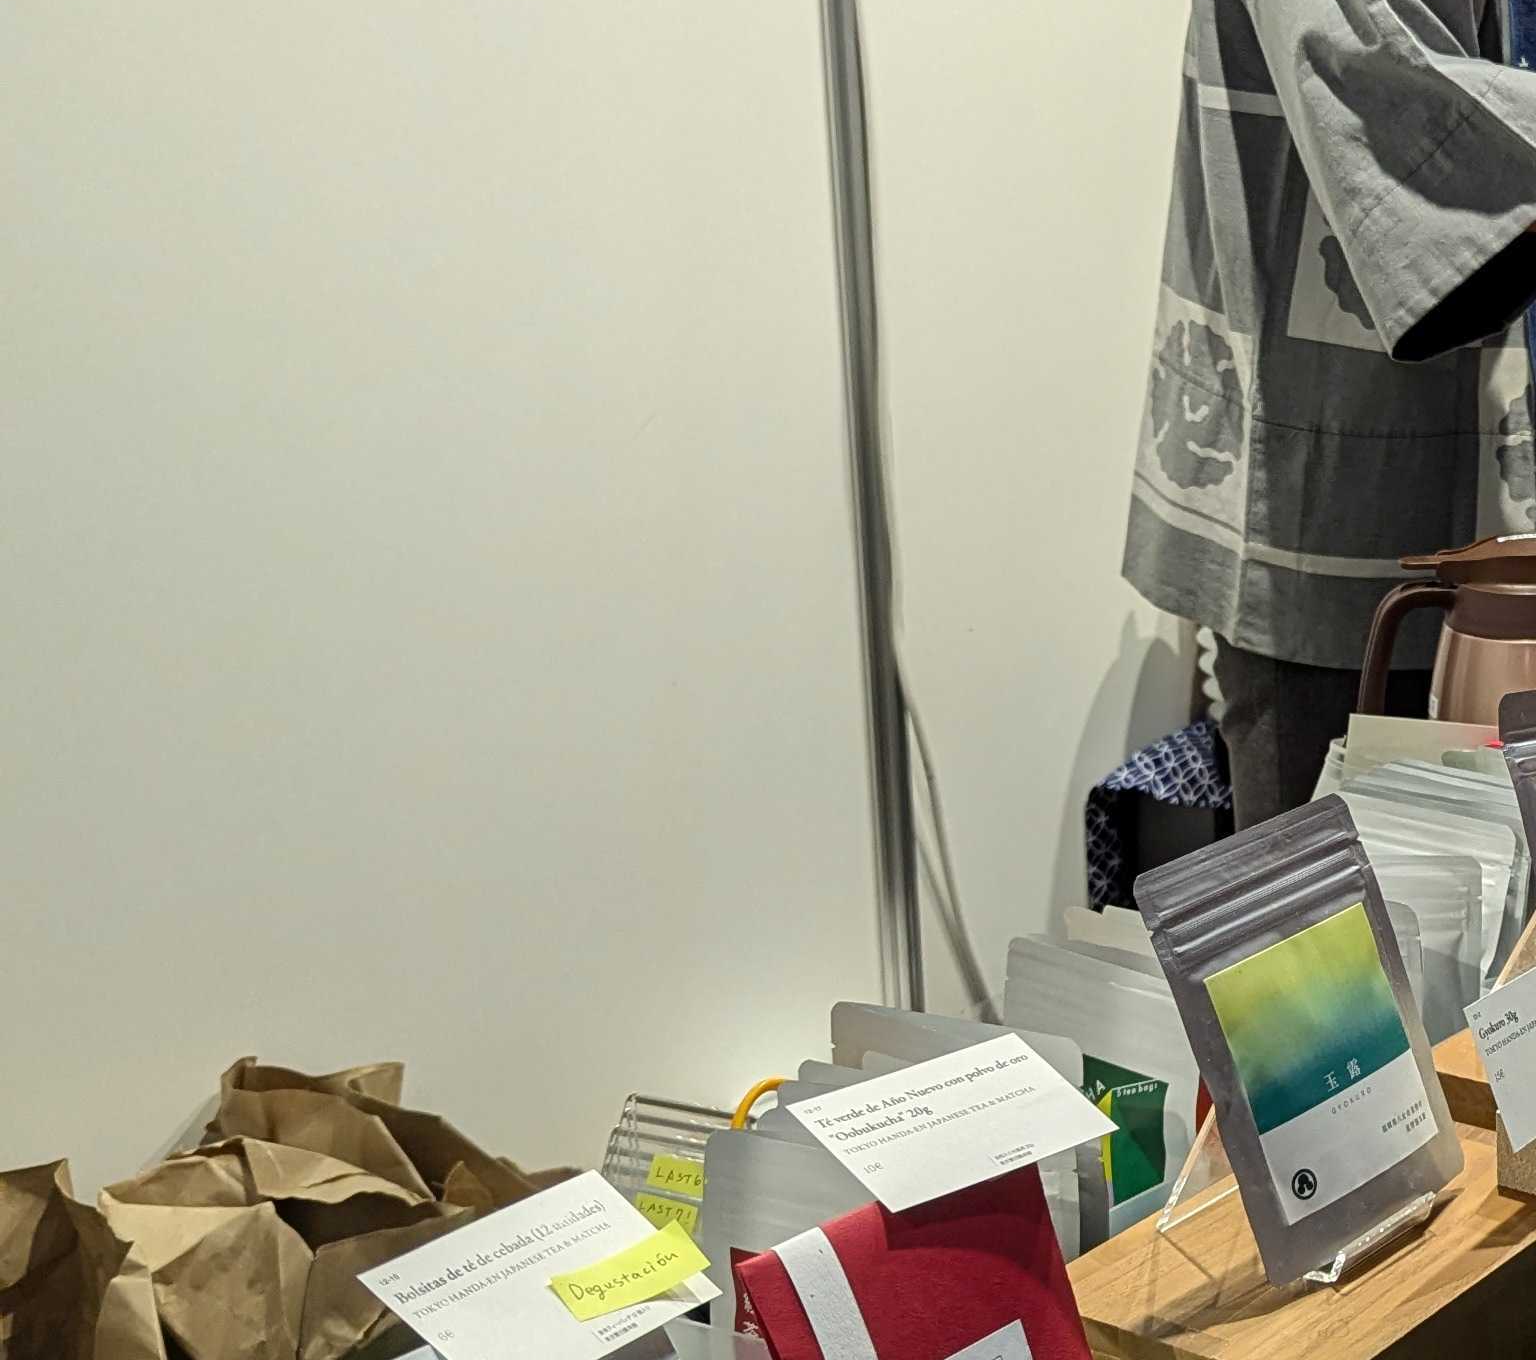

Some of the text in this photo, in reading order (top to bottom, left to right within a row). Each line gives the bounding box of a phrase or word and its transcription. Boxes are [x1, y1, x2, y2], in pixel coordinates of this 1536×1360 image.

[1478, 1010, 1518, 1040] Gyokuro 30g
[813, 1054, 1028, 1128] Té verde de Año Nuevo con polvo de oro
[1324, 1058, 1360, 1091] 玉露
[905, 1106, 933, 1117] 20g
[1330, 1086, 1371, 1114] GYOKURO
[656, 1166, 691, 1186] LAST
[393, 1199, 605, 1303] Bolsitas de té de cebada (12 unidades)
[412, 1298, 449, 1318] TOKYO
[496, 1252, 545, 1279] JAPANESE
[542, 1244, 564, 1256] TEA
[570, 1222, 611, 1242] MATCHA
[570, 1252, 680, 1302] Degustación
